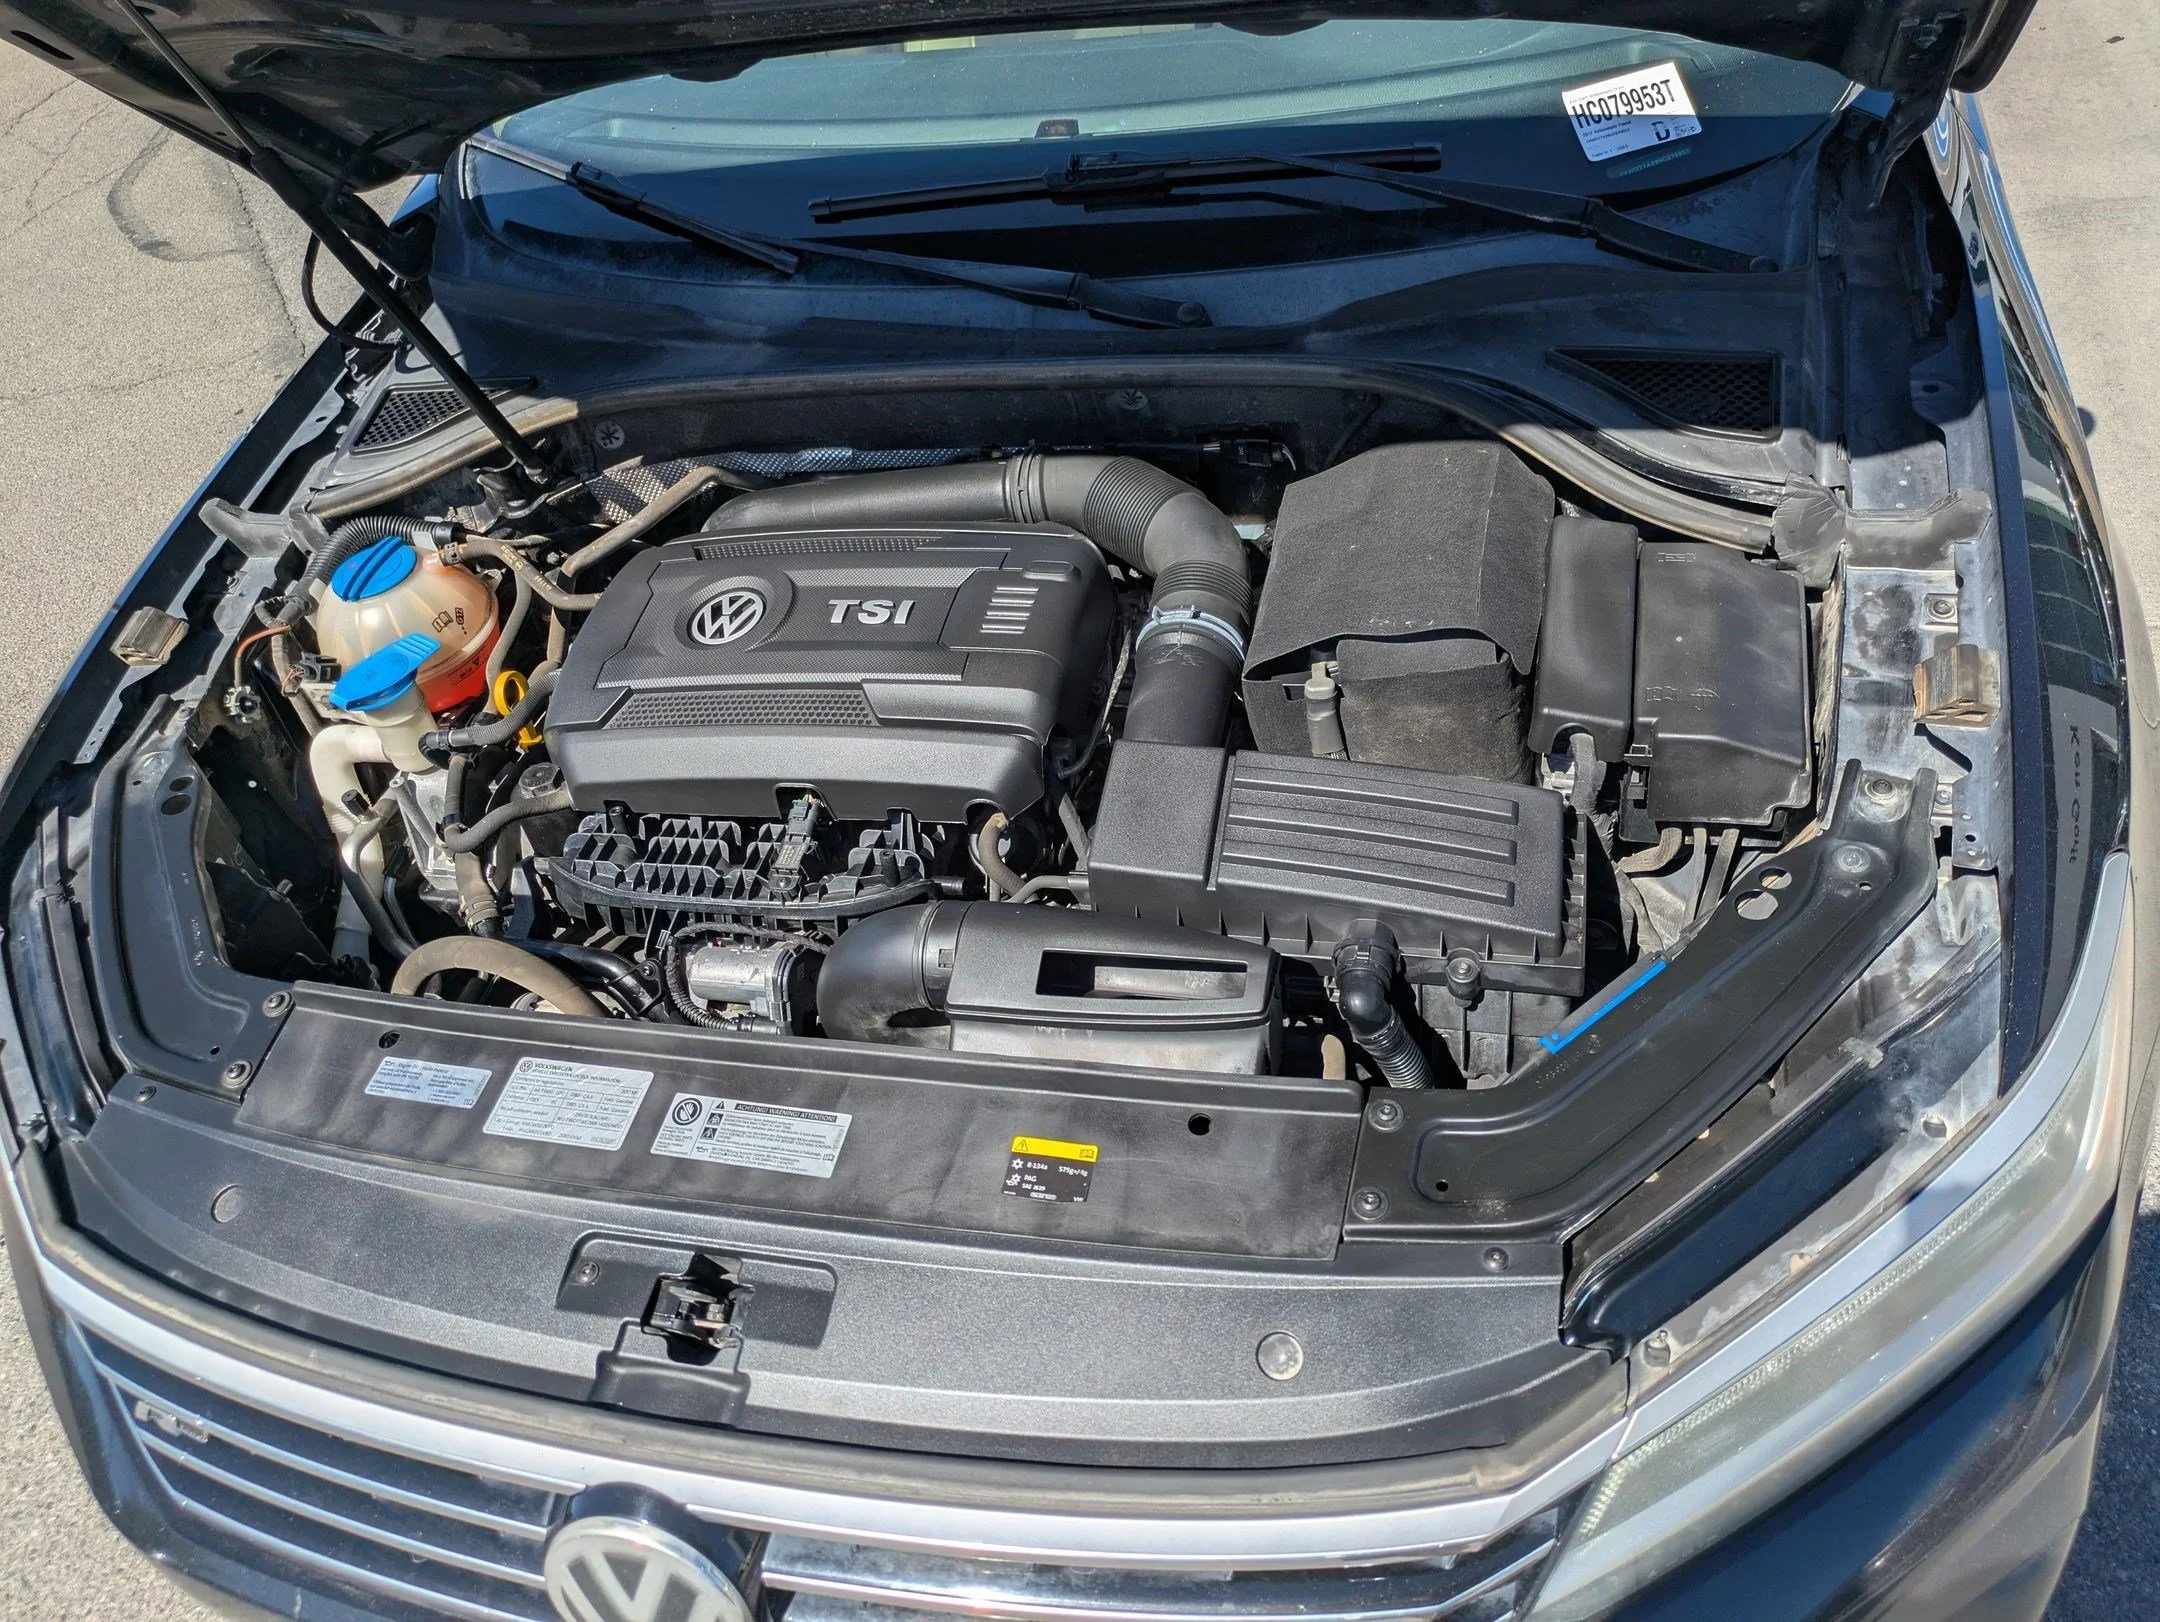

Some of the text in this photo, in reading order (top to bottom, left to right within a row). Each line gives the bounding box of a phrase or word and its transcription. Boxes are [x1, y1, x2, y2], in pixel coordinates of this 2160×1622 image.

[1572, 79, 1675, 129] HC079953T
[827, 600, 915, 625] TSI
[534, 1062, 574, 1072] VOLKSWAGEN
[736, 1104, 769, 1113] ACHTUNG!
[769, 1108, 800, 1118] WARNING!
[800, 1112, 836, 1122] ATTENTION!
[1024, 1174, 1037, 1182] PAG
